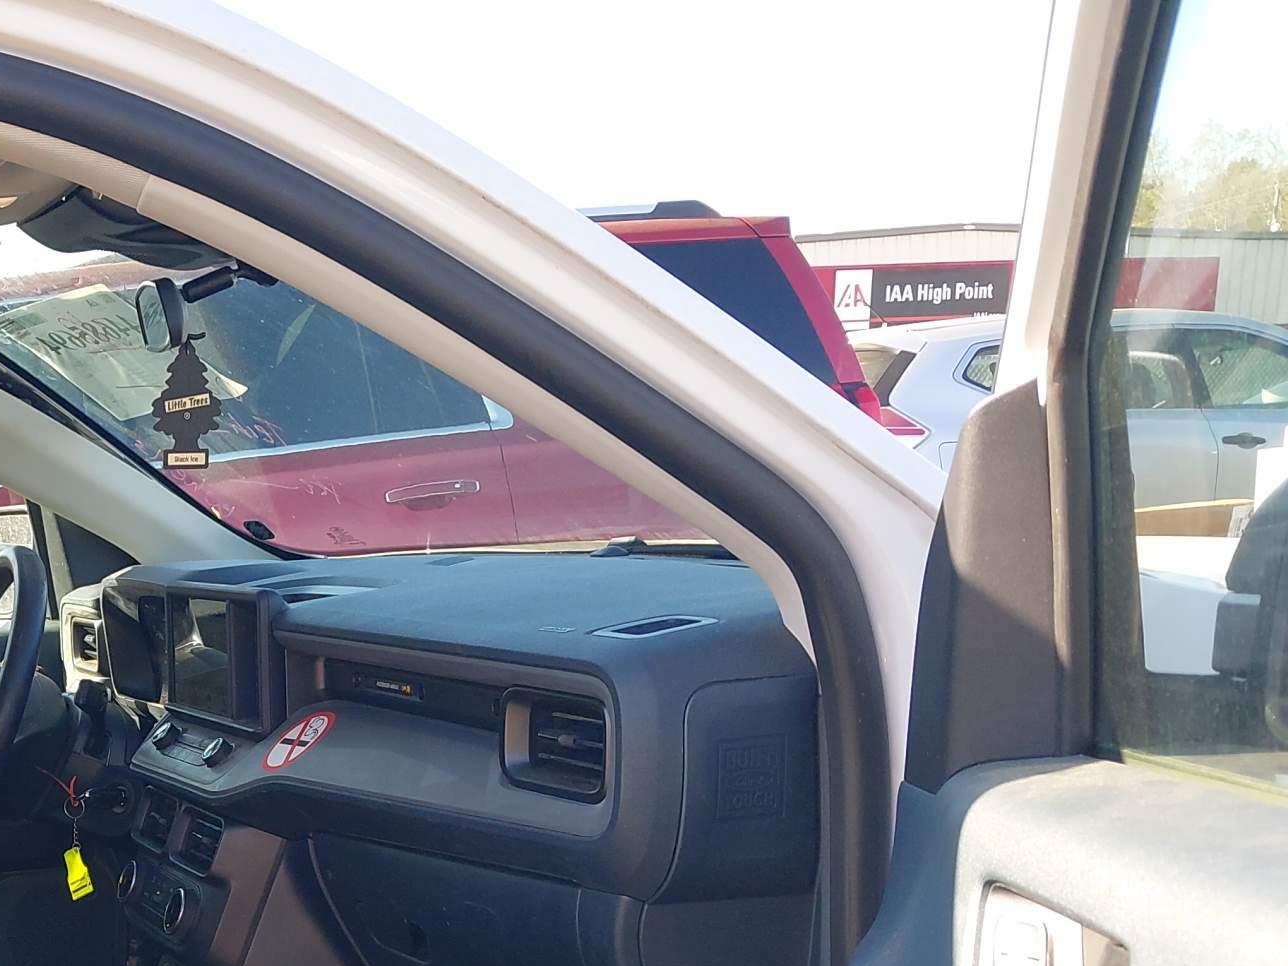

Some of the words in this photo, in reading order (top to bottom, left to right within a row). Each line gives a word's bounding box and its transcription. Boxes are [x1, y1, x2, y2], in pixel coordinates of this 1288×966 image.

[885, 284, 913, 303] IAA
[917, 283, 951, 304] High
[955, 281, 993, 300] Point
[168, 399, 187, 411] Little
[189, 397, 208, 407] Trees
